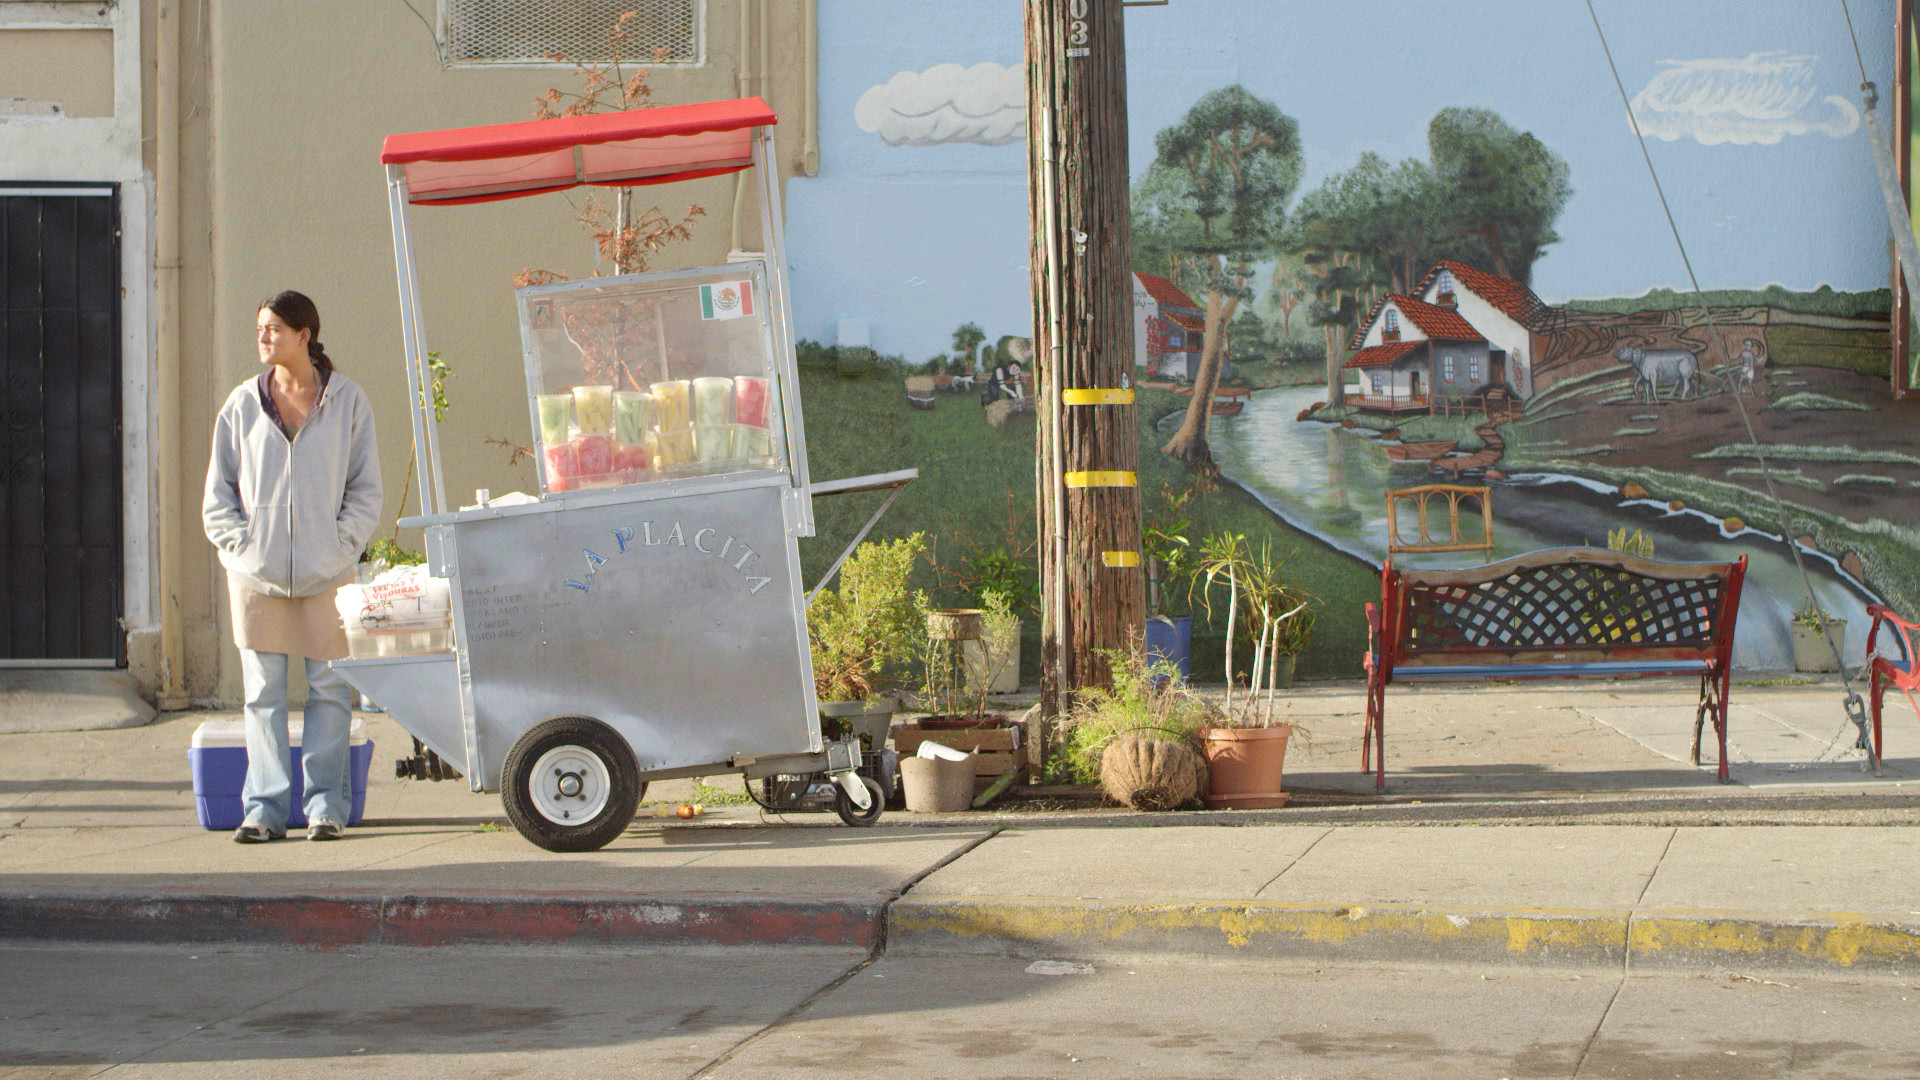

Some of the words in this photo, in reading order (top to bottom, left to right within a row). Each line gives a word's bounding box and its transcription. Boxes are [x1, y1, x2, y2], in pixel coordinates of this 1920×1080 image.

[563, 549, 609, 592] LA
[612, 520, 772, 596] PLACITA
[372, 581, 406, 593] FRUAS
